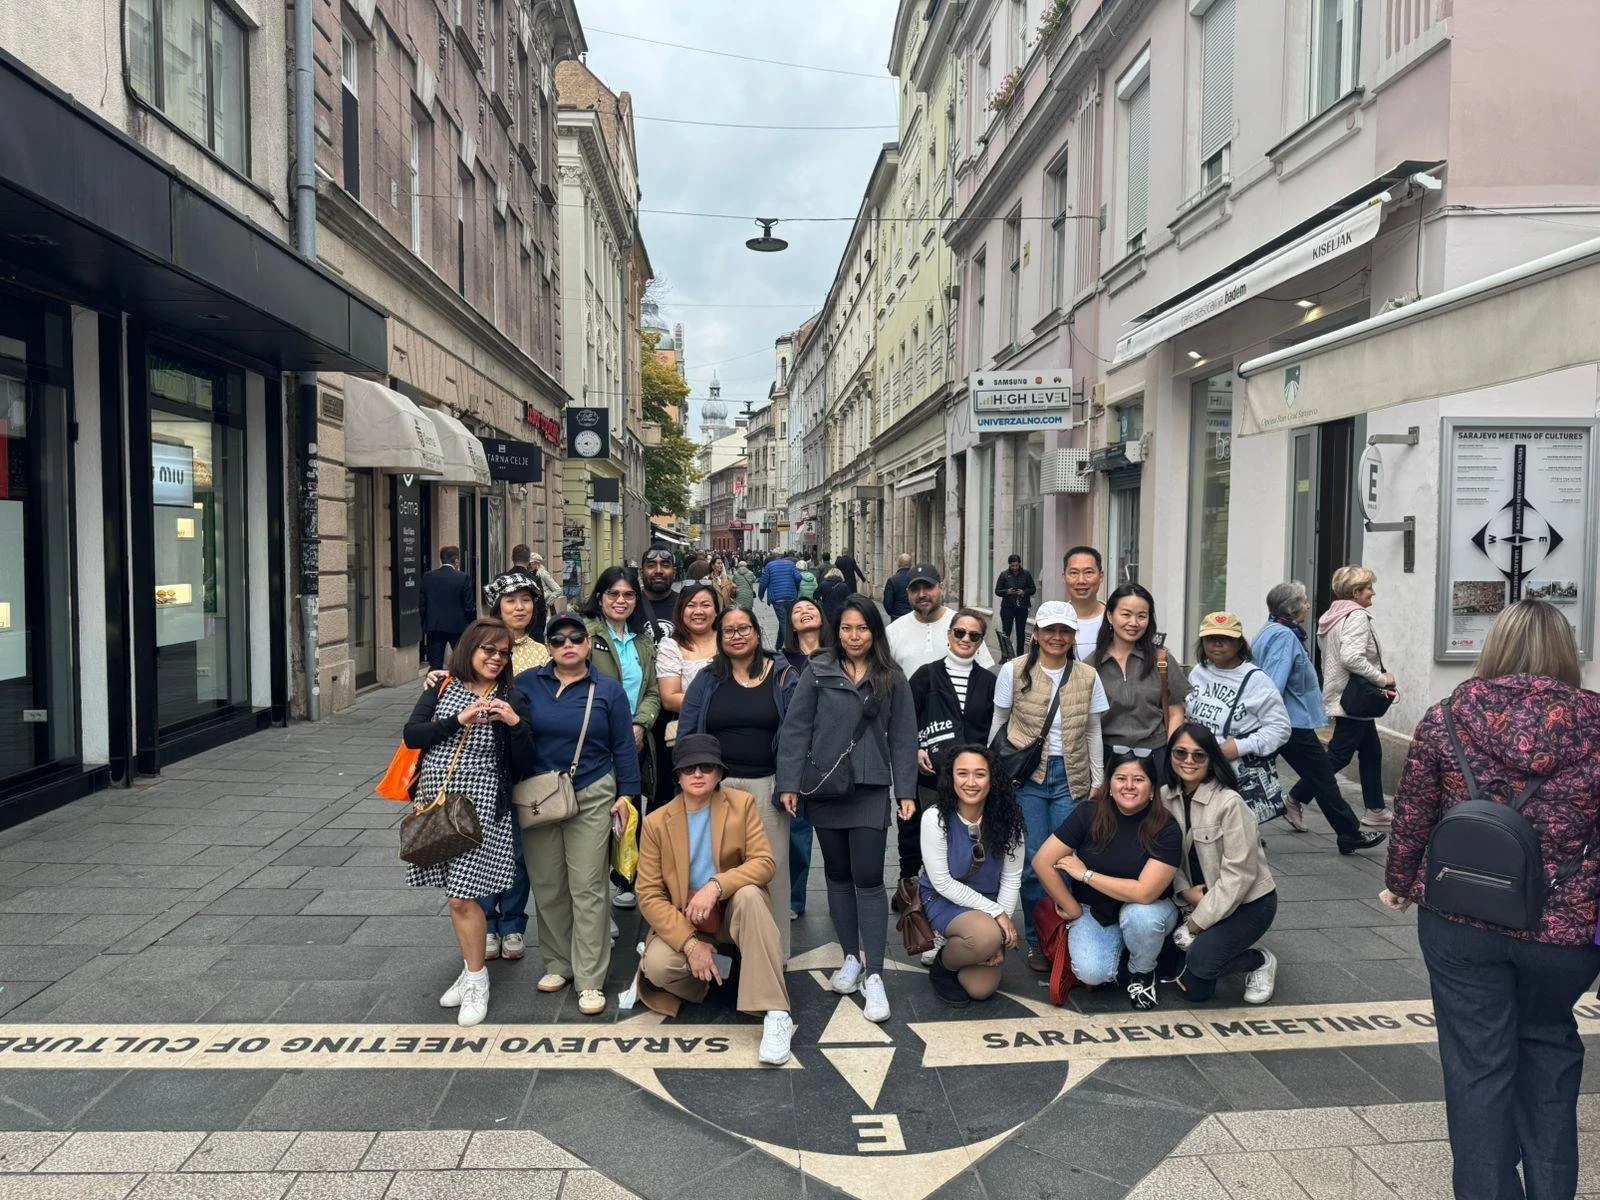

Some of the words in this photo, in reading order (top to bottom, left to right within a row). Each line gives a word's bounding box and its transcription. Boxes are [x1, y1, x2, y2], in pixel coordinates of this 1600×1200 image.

[1312, 230, 1352, 260] KISELJAK
[1224, 283, 1247, 304] badem
[993, 378, 1028, 386] SAMSUNG
[993, 393, 1027, 405] HIGH
[1031, 391, 1067, 404] LEVEL
[977, 416, 1062, 426] UNIVERZALNO.COM
[1458, 432, 1497, 440] SARAJEVO
[1498, 432, 1532, 440] MEETING
[1533, 432, 1543, 440] OF
[1544, 432, 1583, 440] CULTURES
[509, 456, 529, 466] CELJE
[1368, 464, 1378, 502] E
[1192, 700, 1223, 721] WEST
[982, 1023, 1204, 1049] SARAJEVO
[1210, 1014, 1403, 1038] MEETING
[1406, 1011, 1437, 1028] O
[203, 1036, 271, 1053] OF
[280, 1036, 488, 1053] MEETING
[500, 1036, 731, 1053] SARAJEVO
[851, 1114, 907, 1152] E
